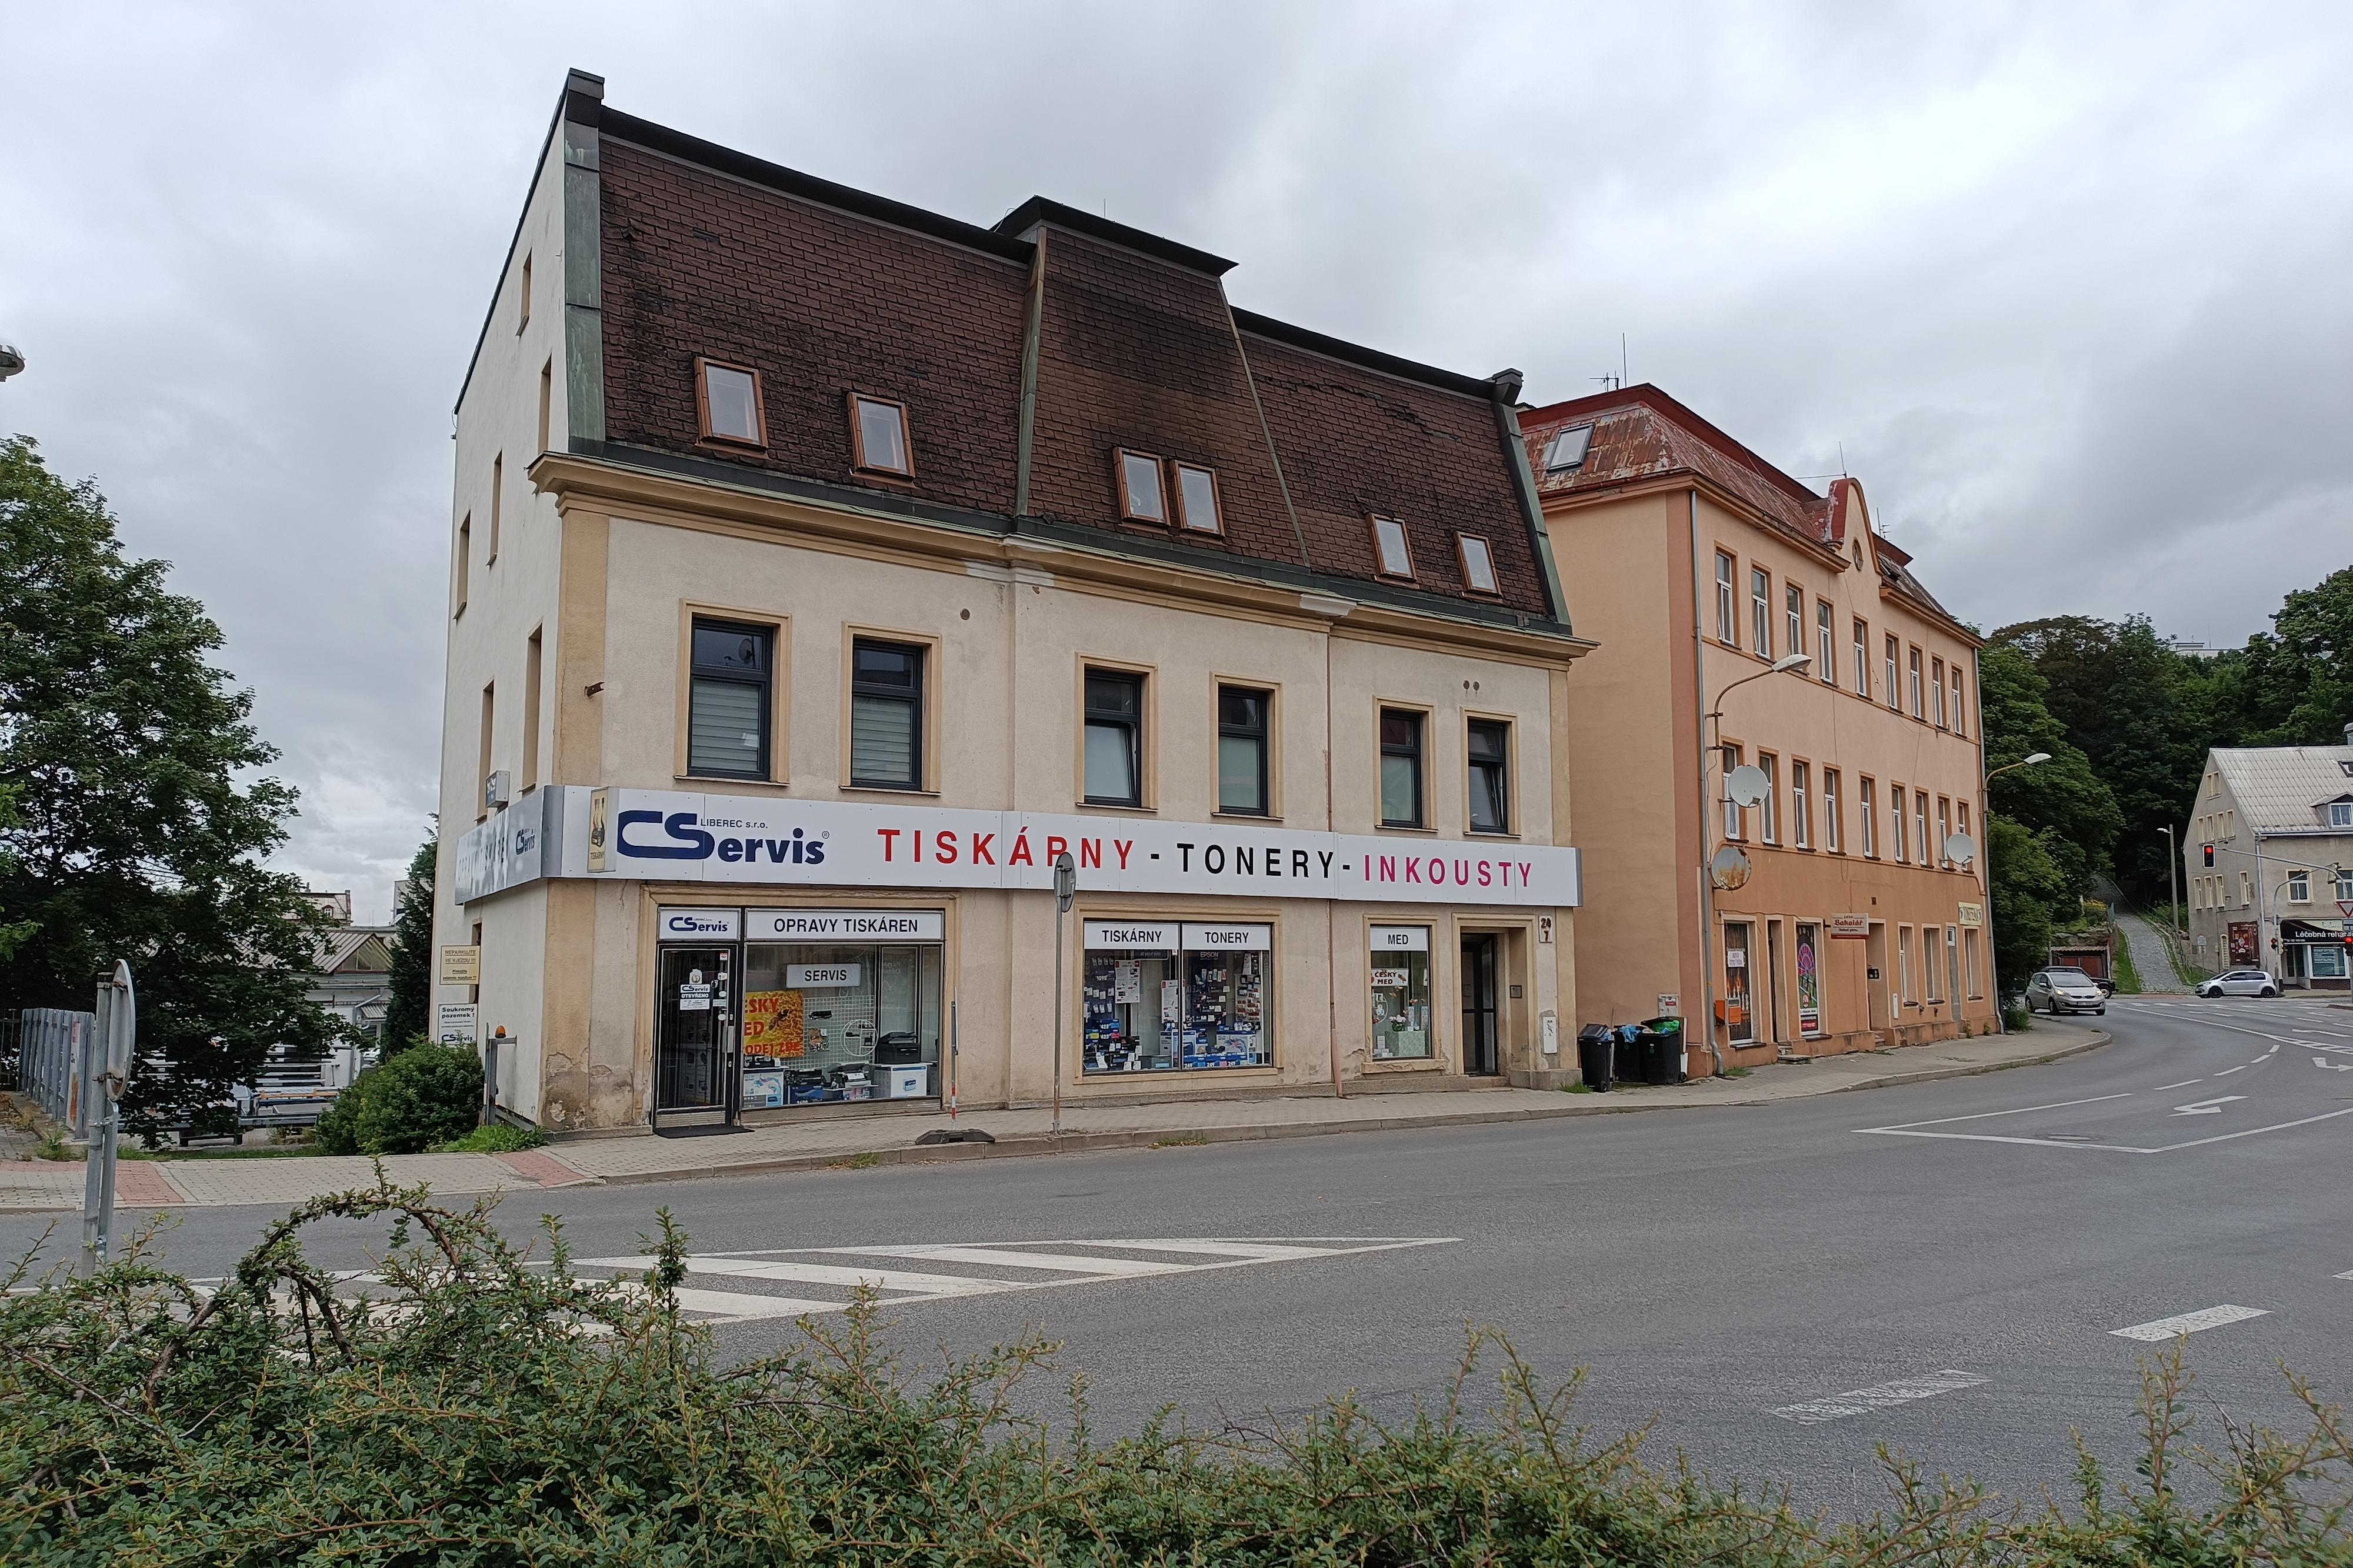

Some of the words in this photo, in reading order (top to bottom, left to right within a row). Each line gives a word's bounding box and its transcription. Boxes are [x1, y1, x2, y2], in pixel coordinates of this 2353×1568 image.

[700, 818, 742, 828] LIBEREC
[877, 826, 1133, 870] TISKÁRNY
[1176, 843, 1334, 879] TONERY
[1364, 855, 1532, 888] INKOUSTY
[774, 918, 838, 933] OPRAVY
[844, 916, 918, 932] TISKÁREN
[1541, 918, 1551, 928] 24
[1102, 928, 1162, 943] TISKÁRNY
[1205, 932, 1249, 944] TONERY
[1388, 934, 1408, 945] MED
[804, 969, 847, 982] SERVIS
